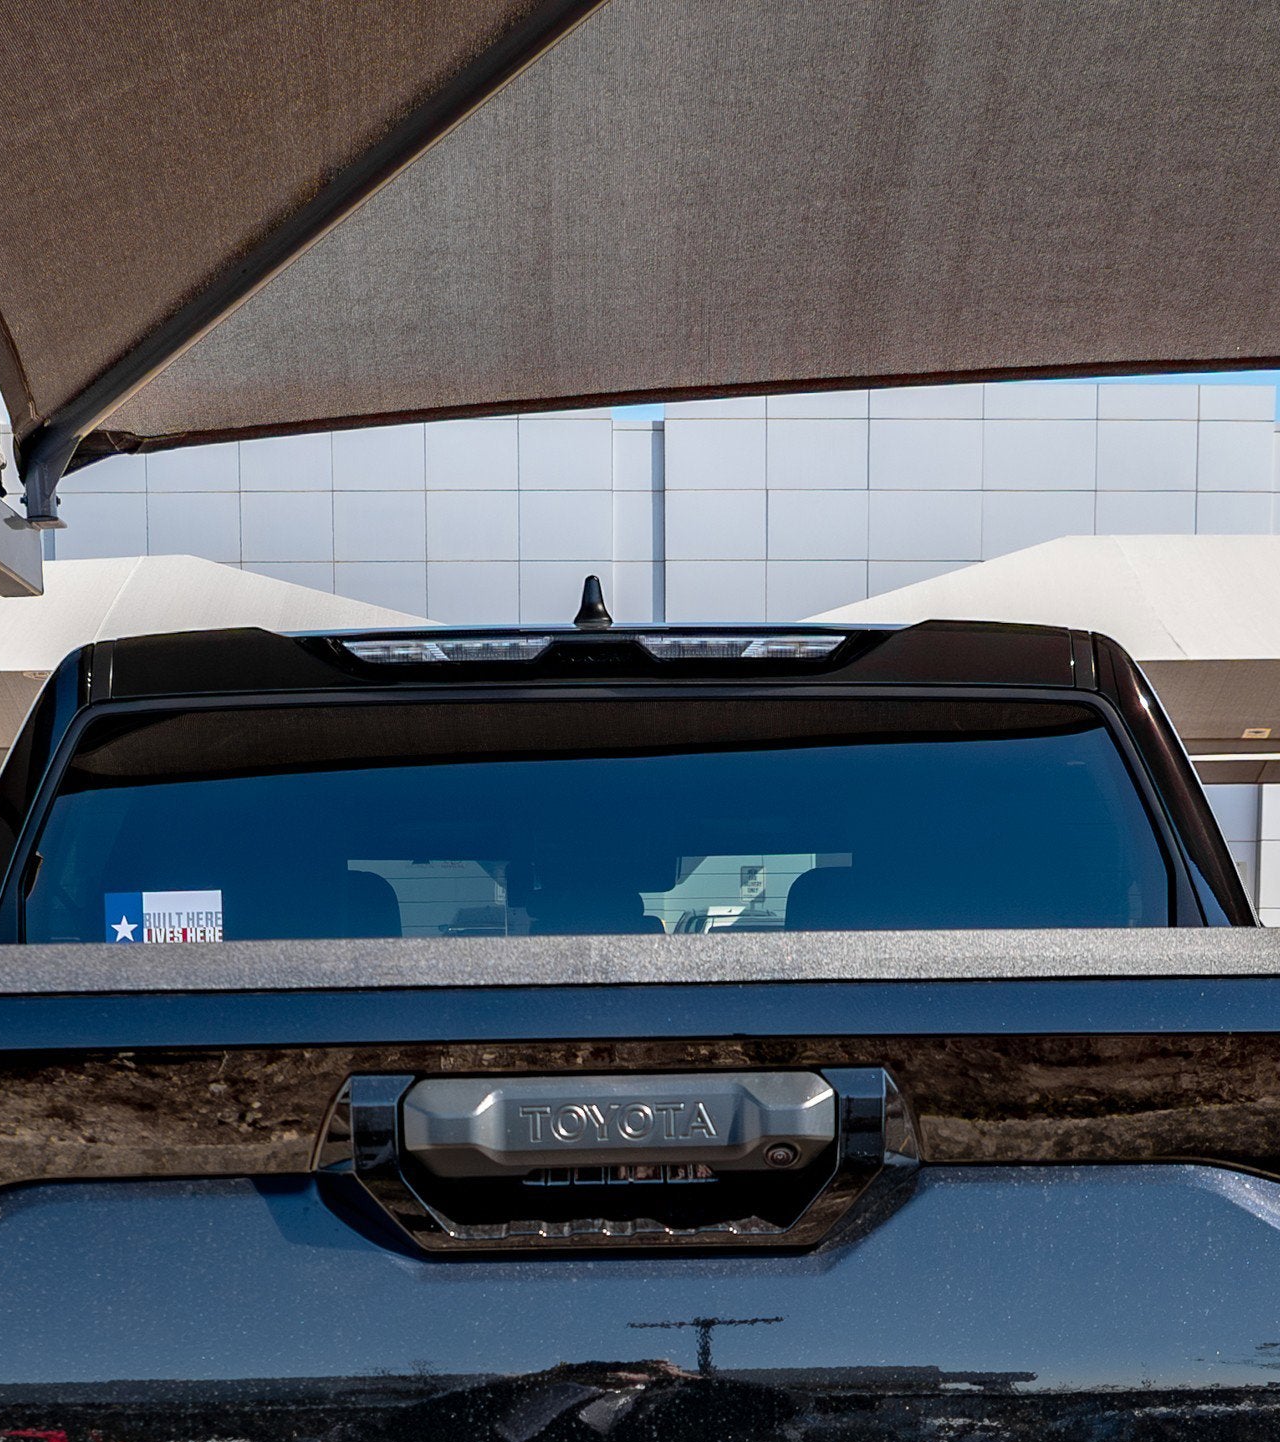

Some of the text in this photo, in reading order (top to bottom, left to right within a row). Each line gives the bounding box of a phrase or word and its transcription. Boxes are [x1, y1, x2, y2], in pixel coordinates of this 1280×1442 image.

[144, 911, 222, 929] BUILT HERE
[143, 926, 223, 943] LIVES HERE
[519, 1102, 719, 1143] TOYOTA
